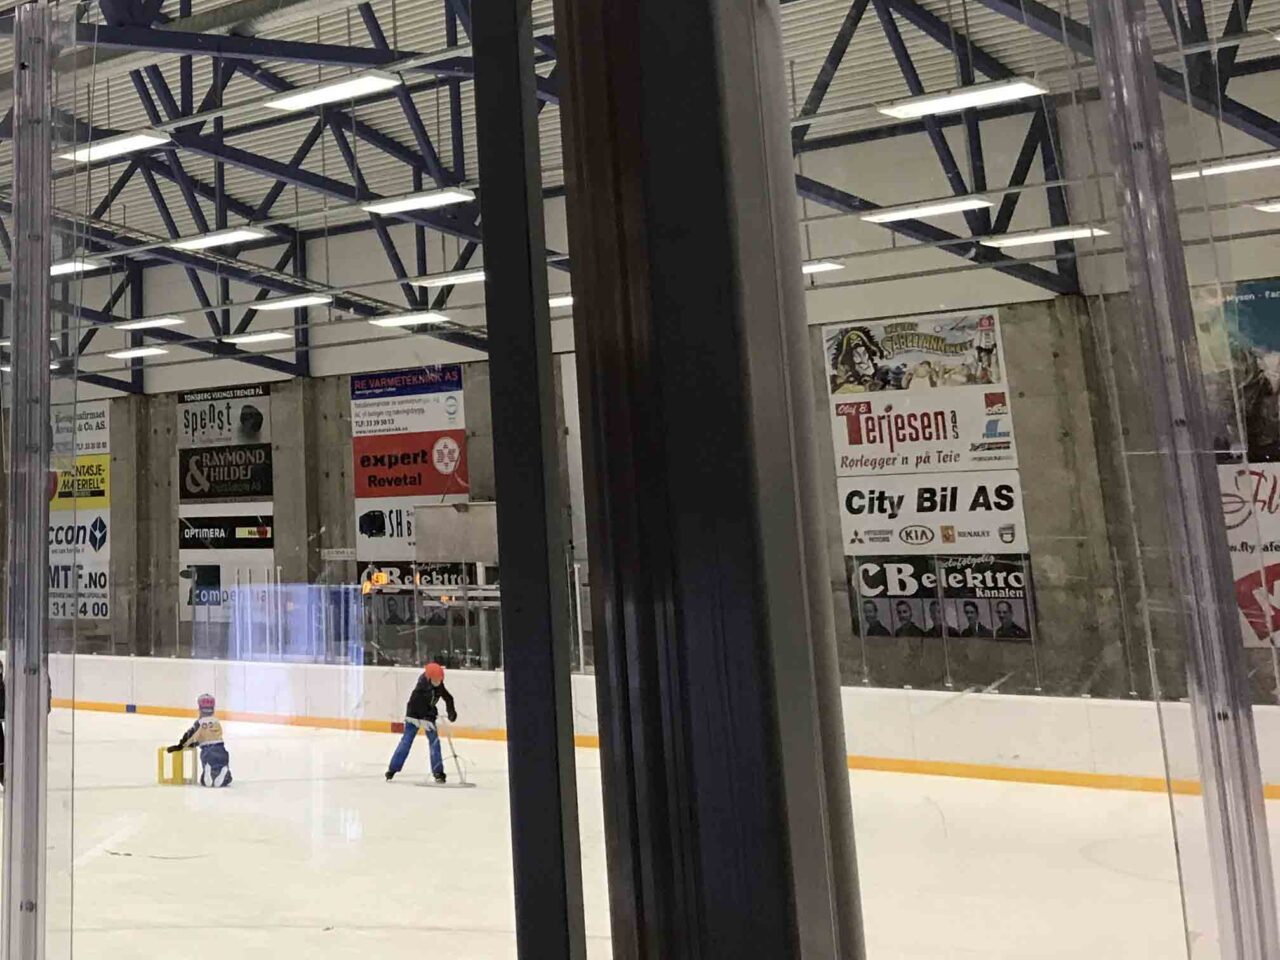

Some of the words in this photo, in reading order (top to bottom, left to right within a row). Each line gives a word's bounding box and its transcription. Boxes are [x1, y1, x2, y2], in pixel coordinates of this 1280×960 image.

[445, 371, 458, 380] AS
[835, 401, 947, 453] Terjesen
[202, 448, 265, 466] RAYMOND
[360, 449, 428, 469] expert
[368, 472, 422, 488] Revetal
[845, 490, 904, 519] City
[916, 487, 958, 513] Bil
[969, 484, 1014, 512] AS
[184, 527, 226, 538] OPTIMERA
[904, 530, 929, 541] KIA
[975, 588, 1023, 598] Kanalen
[92, 602, 108, 617] 00
